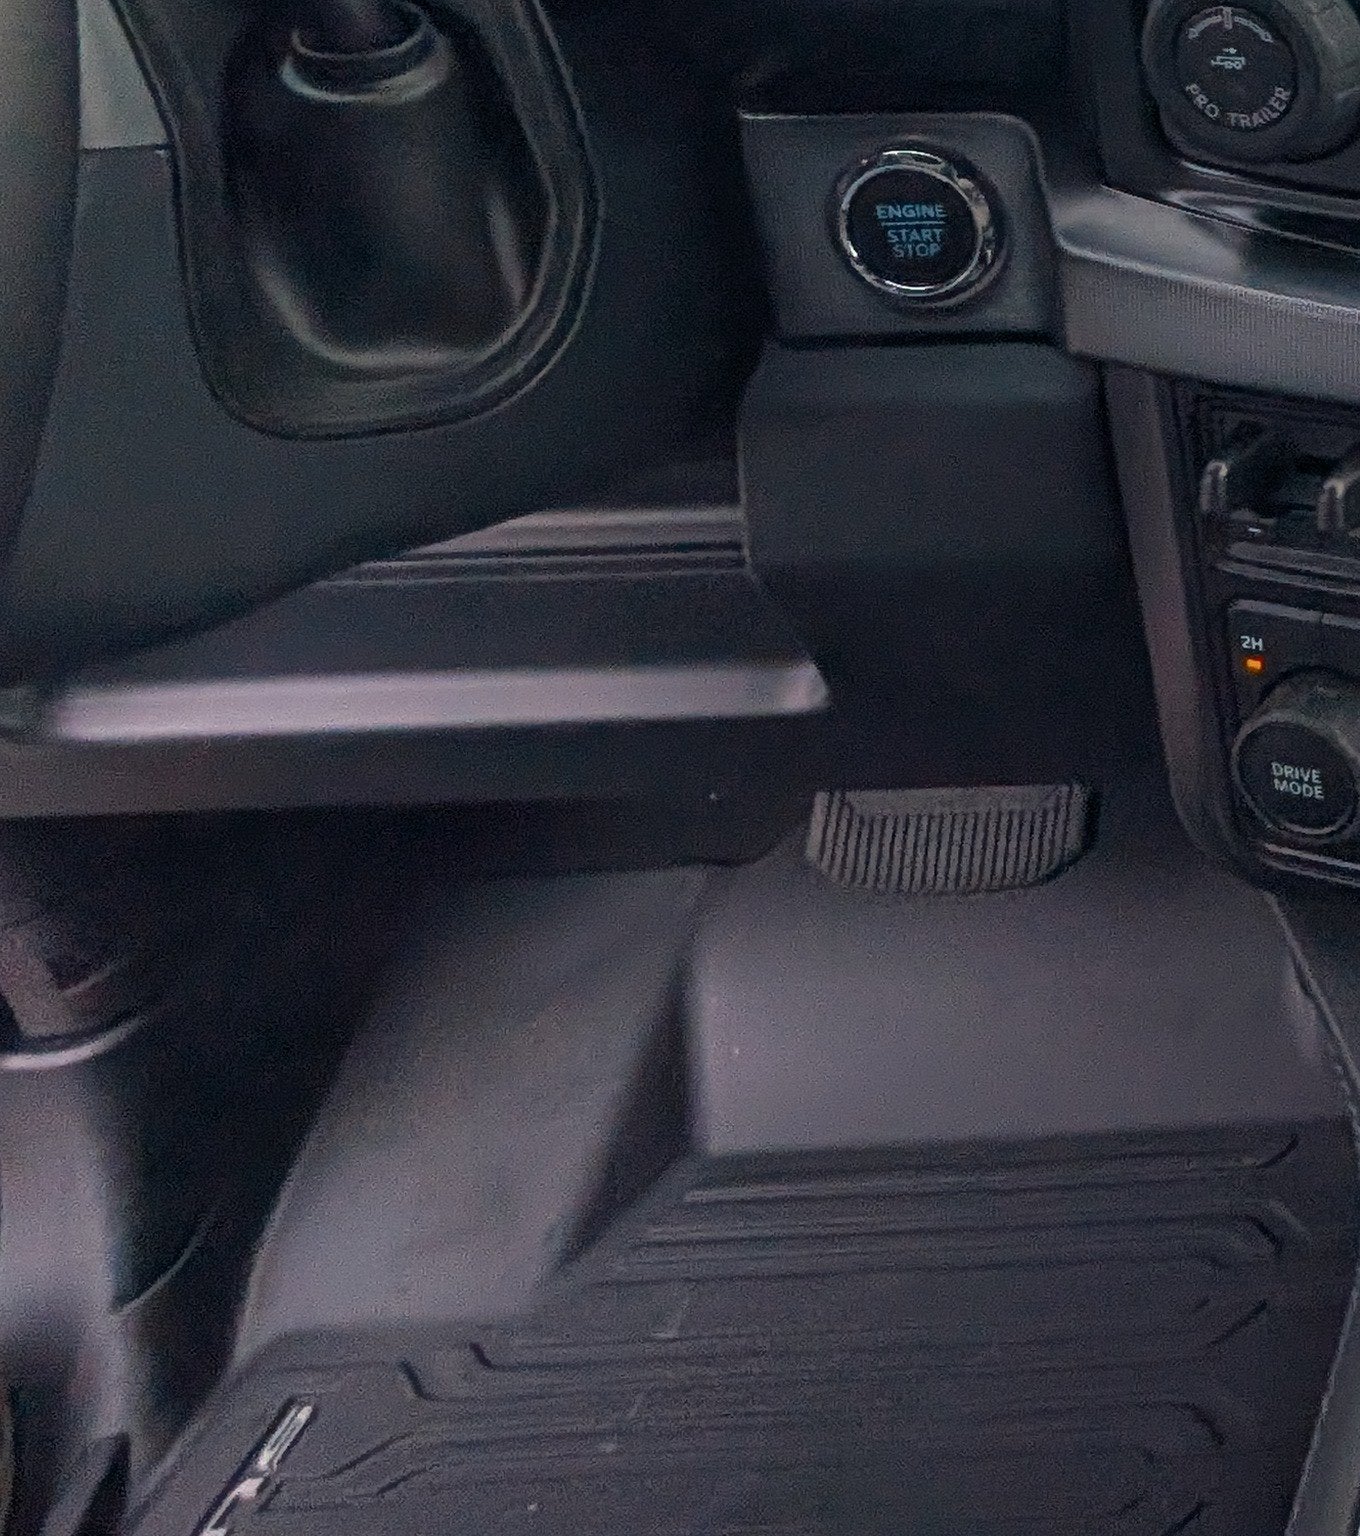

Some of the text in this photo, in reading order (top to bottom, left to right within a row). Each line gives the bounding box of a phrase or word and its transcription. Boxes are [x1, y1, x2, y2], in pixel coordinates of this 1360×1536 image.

[1185, 83, 1291, 128] PRO TRAILER
[876, 204, 948, 220] ENGINE
[887, 228, 943, 243] START
[892, 243, 942, 259] STOP
[1240, 635, 1264, 652] 2H
[1271, 762, 1321, 784] DRIVE
[1274, 778, 1325, 800] MODE
